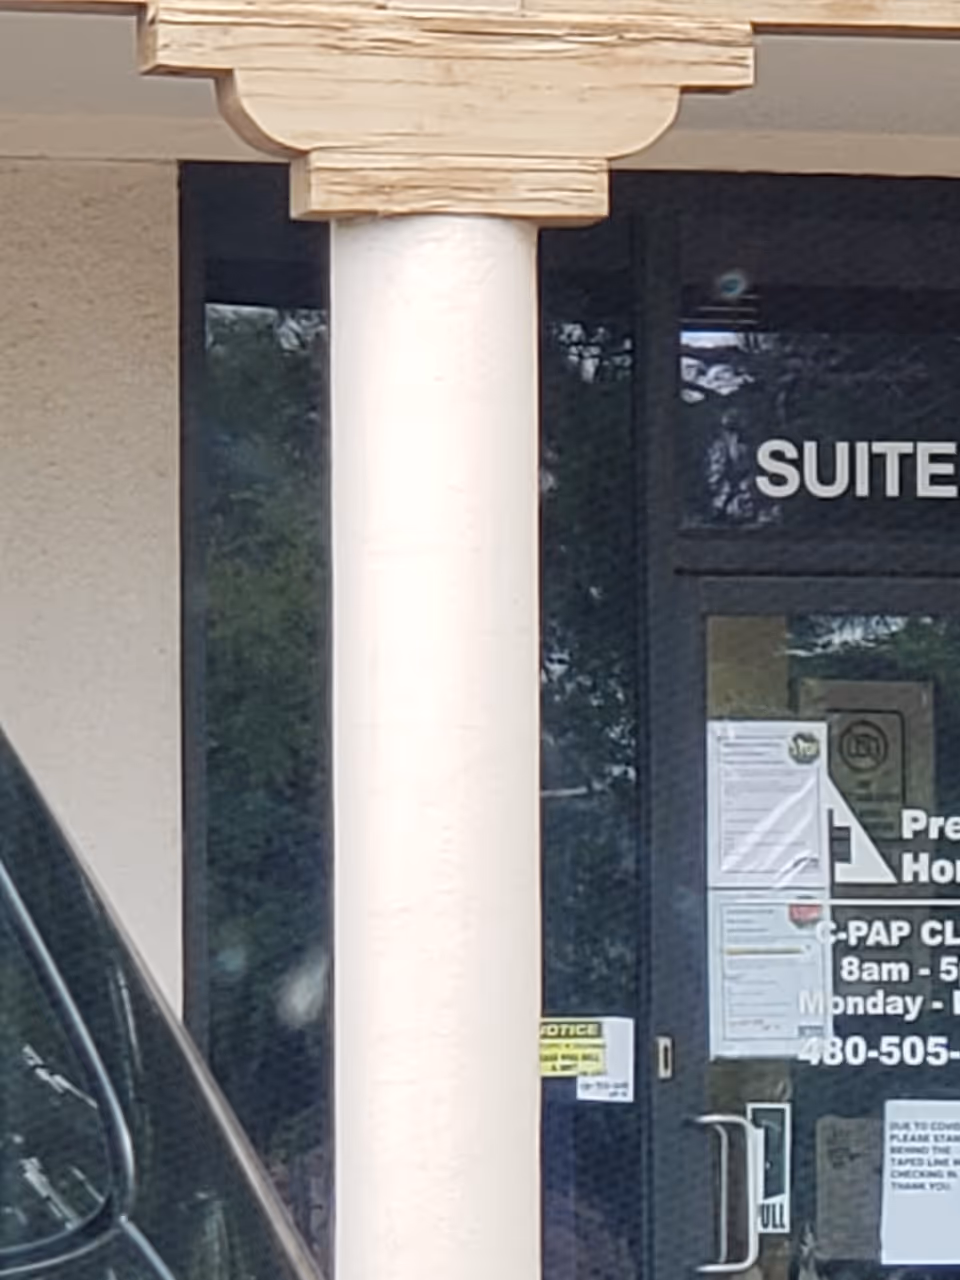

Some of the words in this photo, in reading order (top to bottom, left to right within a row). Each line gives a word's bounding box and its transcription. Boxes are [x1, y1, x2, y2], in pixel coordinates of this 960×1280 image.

[755, 439, 958, 498] SUITE
[816, 919, 912, 947] C-PAP
[840, 956, 911, 982] 8am
[799, 988, 925, 1022] Monday
[889, 1122, 910, 1131] DUE
[914, 1122, 929, 1131] TO
[889, 1134, 930, 1143] PLEASE
[890, 1146, 930, 1155] BEHIND
[932, 1146, 952, 1155] THE
[890, 1158, 925, 1167] TAPED
[927, 1158, 950, 1167] LINE
[890, 1170, 944, 1179] CHECKING
[890, 1182, 926, 1190] THANK
[760, 1202, 787, 1230] ULL
